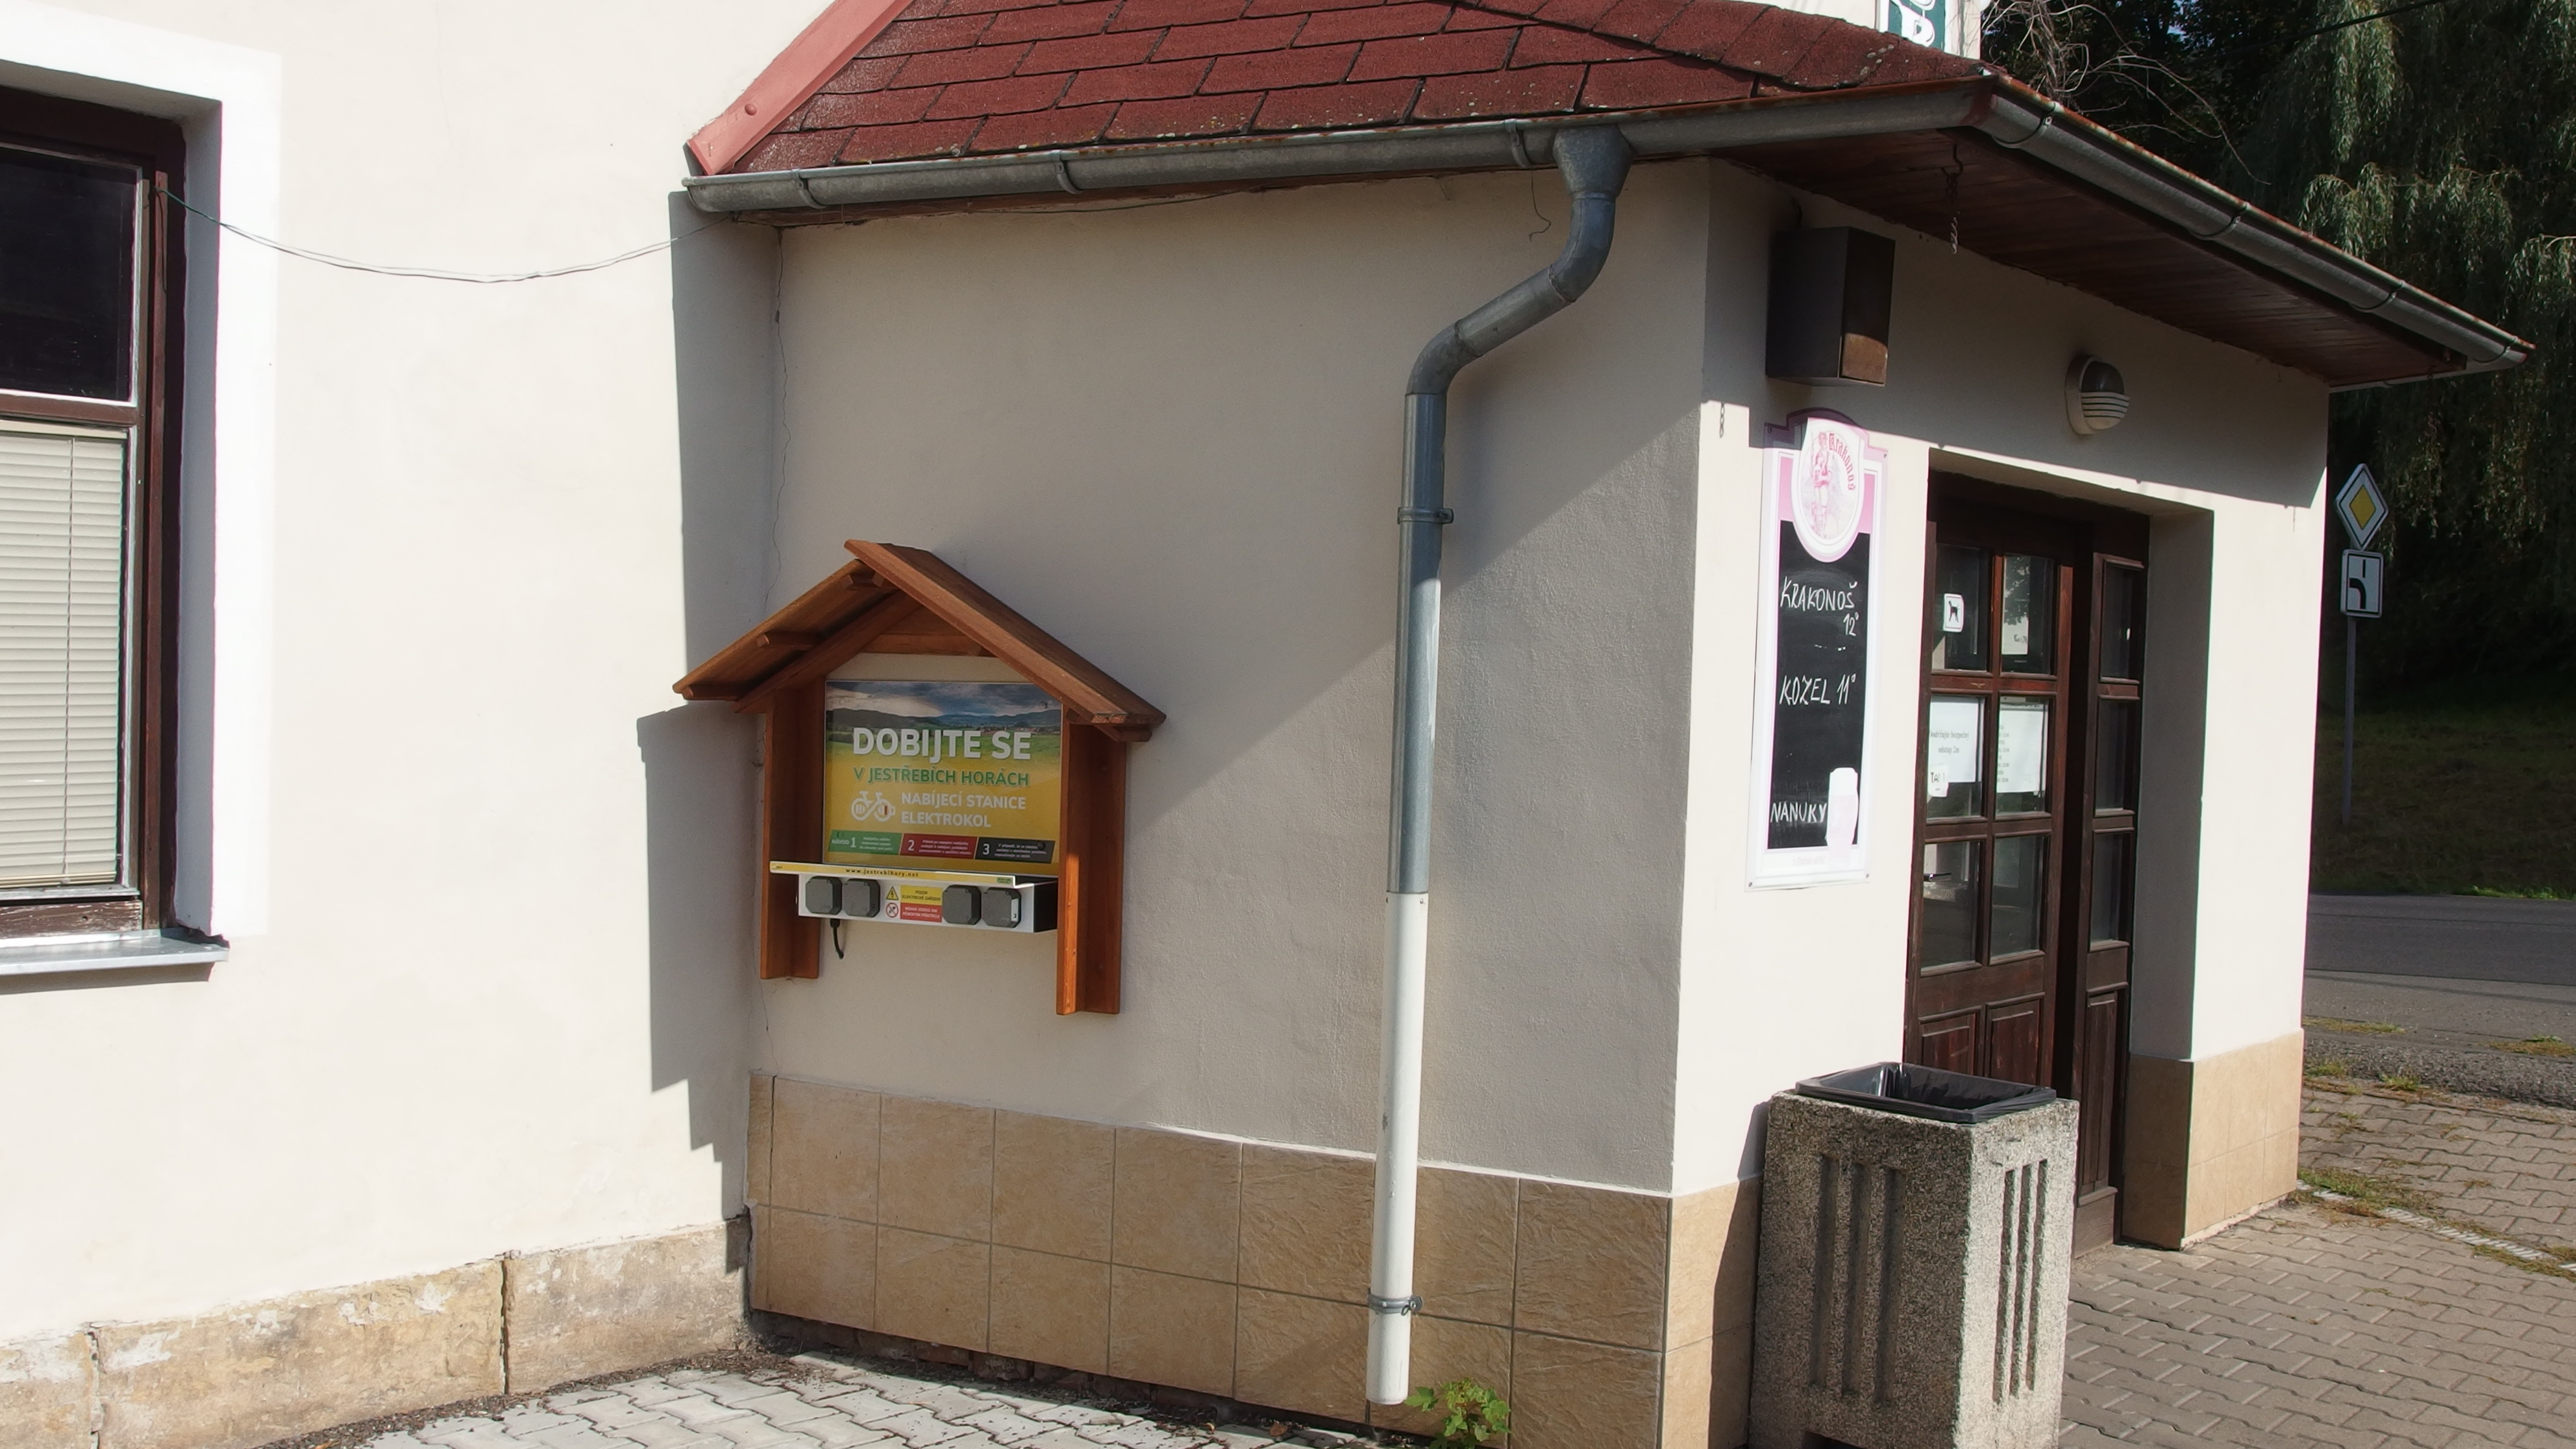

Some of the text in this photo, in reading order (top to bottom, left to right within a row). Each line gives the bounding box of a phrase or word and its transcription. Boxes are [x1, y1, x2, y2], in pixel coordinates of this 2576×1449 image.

[1779, 575, 1858, 612] KRAKONOŠ
[1779, 675, 1831, 706] KOZEL
[852, 727, 1032, 764] DOBIJTE SE
[853, 764, 1030, 786] V JESTŘEBÍCH HORÁCH
[901, 789, 1026, 810] NABÍJECÍ STANICE
[901, 812, 991, 828] ELEKTROKOL
[1770, 800, 1828, 824] NANUKY
[850, 837, 856, 848] 1
[908, 839, 915, 851] 2
[983, 843, 990, 855] 3
